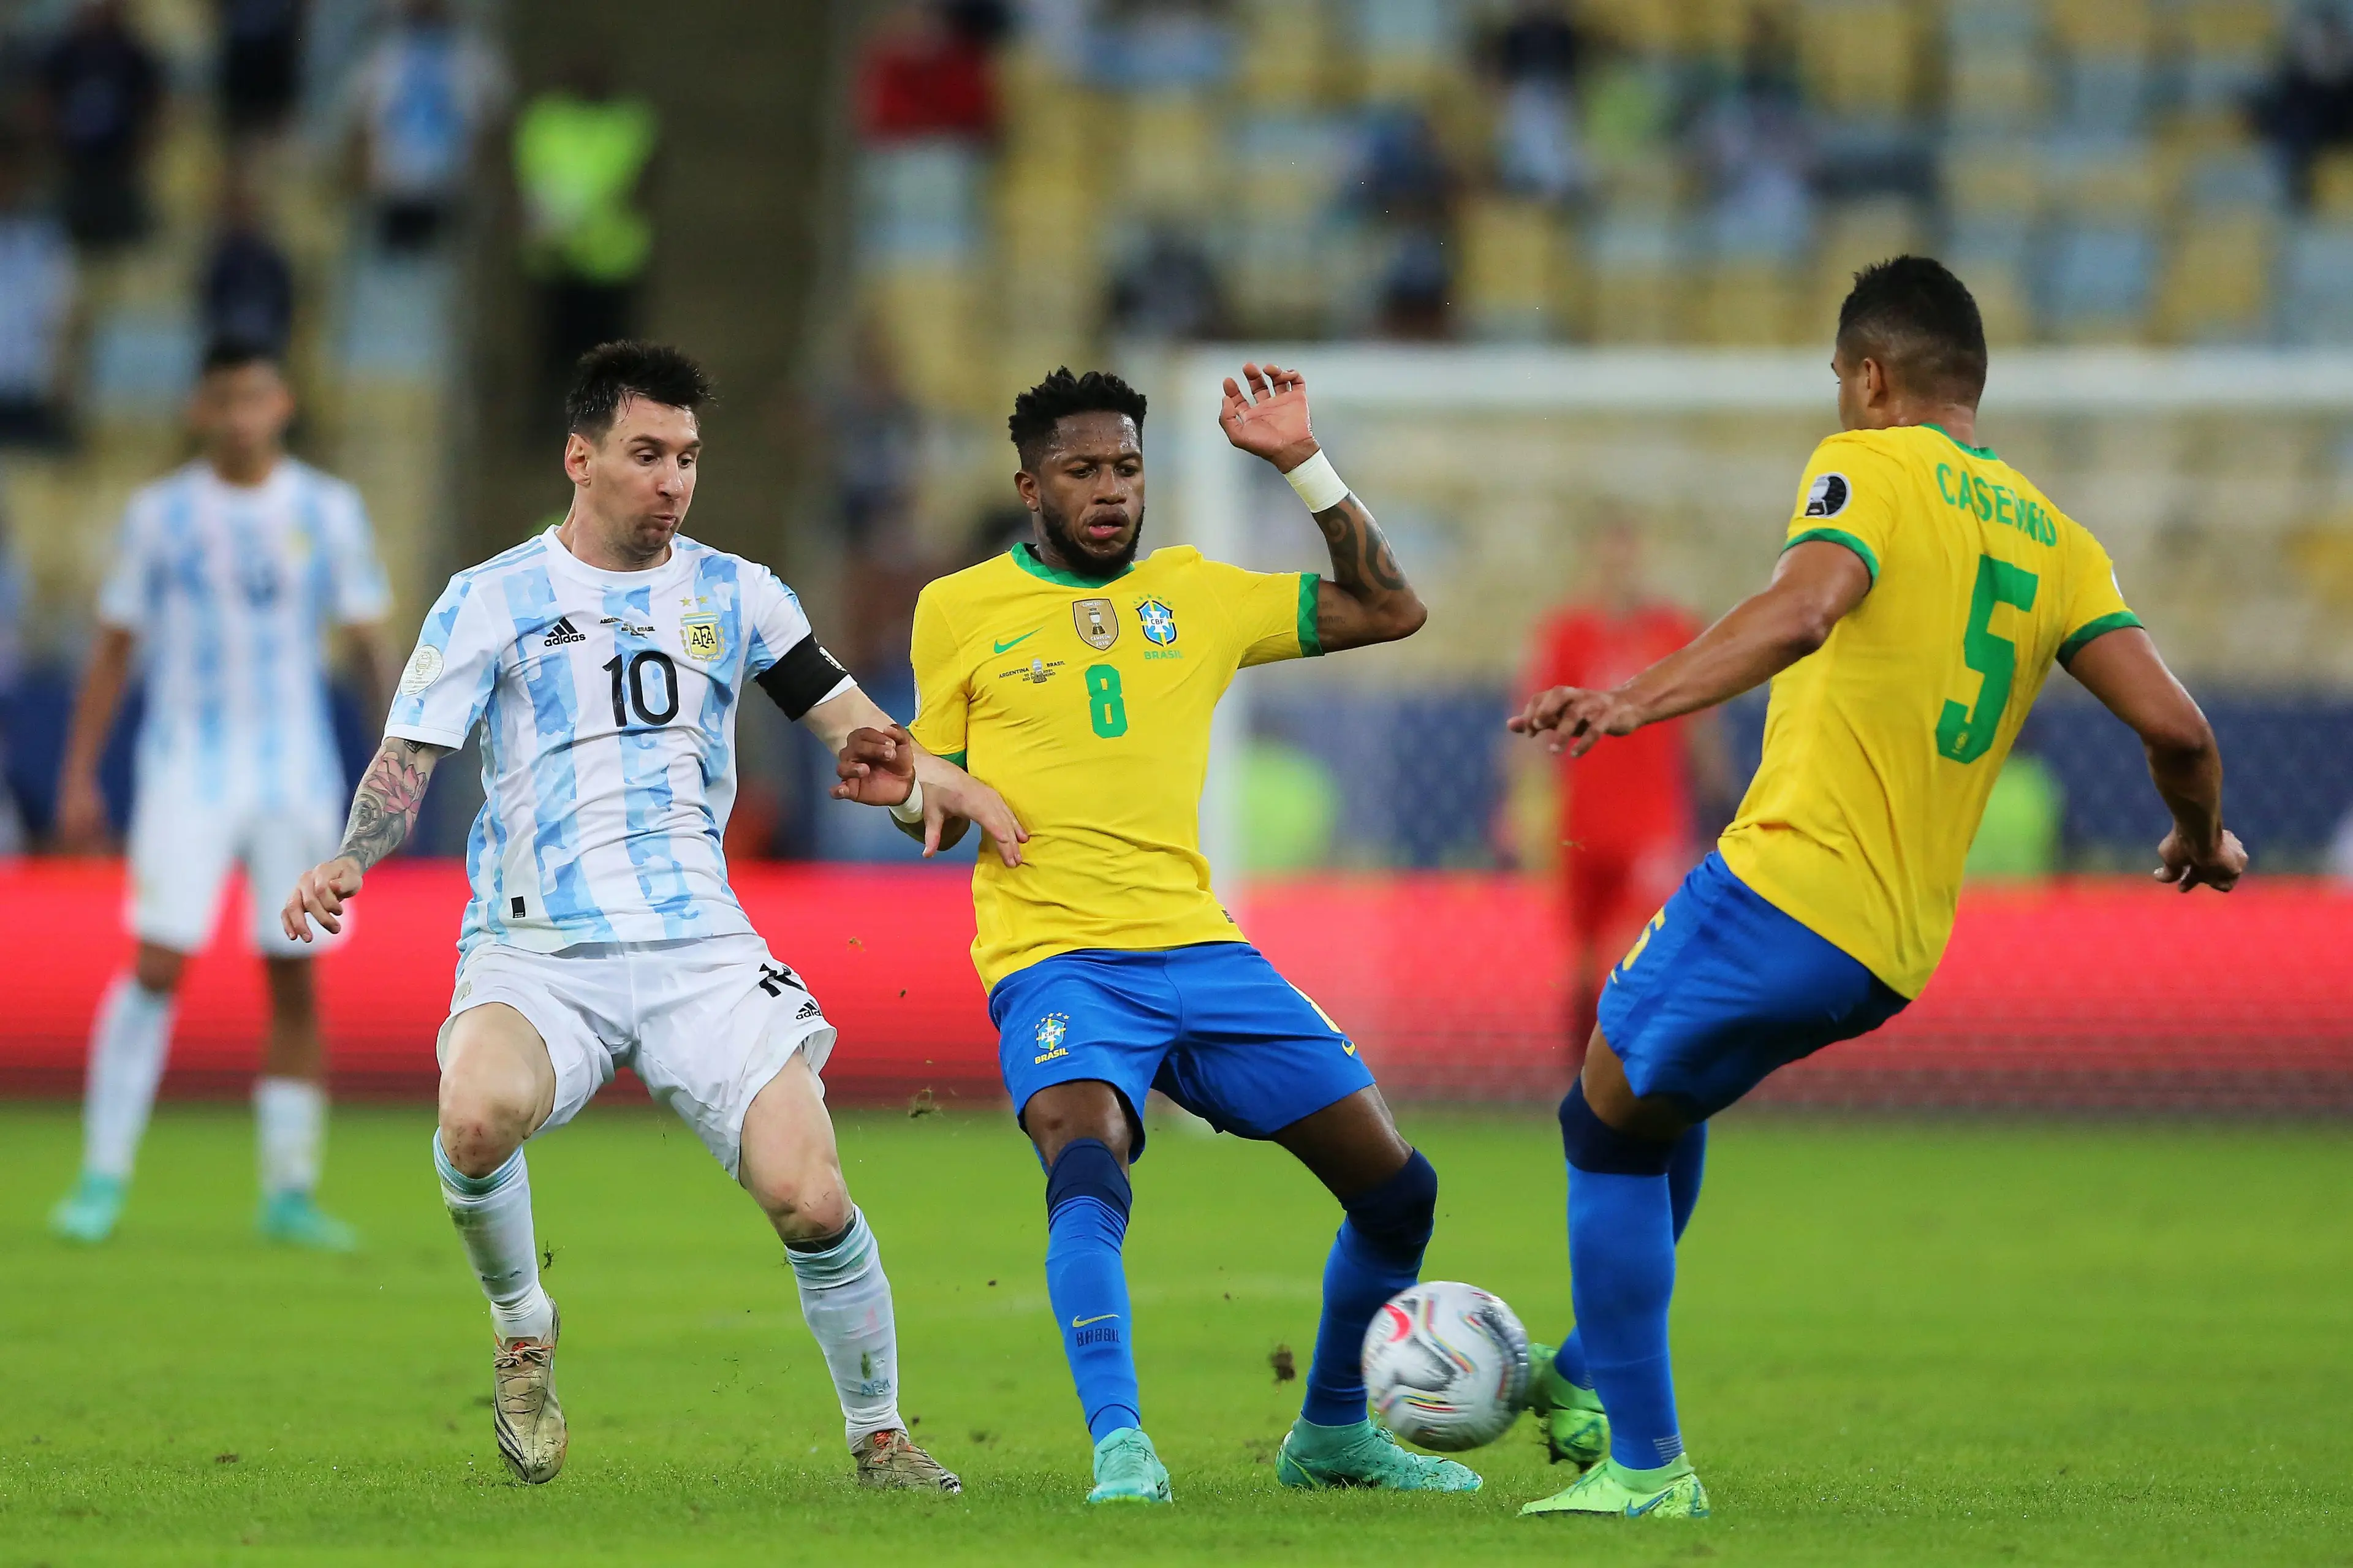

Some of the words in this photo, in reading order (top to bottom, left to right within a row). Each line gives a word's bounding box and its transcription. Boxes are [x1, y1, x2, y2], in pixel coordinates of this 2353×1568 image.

[1936, 463, 2056, 547] CASEMRO
[544, 634, 586, 647] adidas
[692, 625, 716, 649] AFA
[1144, 650, 1183, 659] BRASIL
[1935, 553, 2039, 765] 5
[999, 667, 1029, 679] ARGENTINA
[602, 650, 679, 727] 10
[1085, 664, 1128, 739] 8
[796, 1008, 822, 1020] adid
[1034, 1048, 1069, 1065] BRASIL
